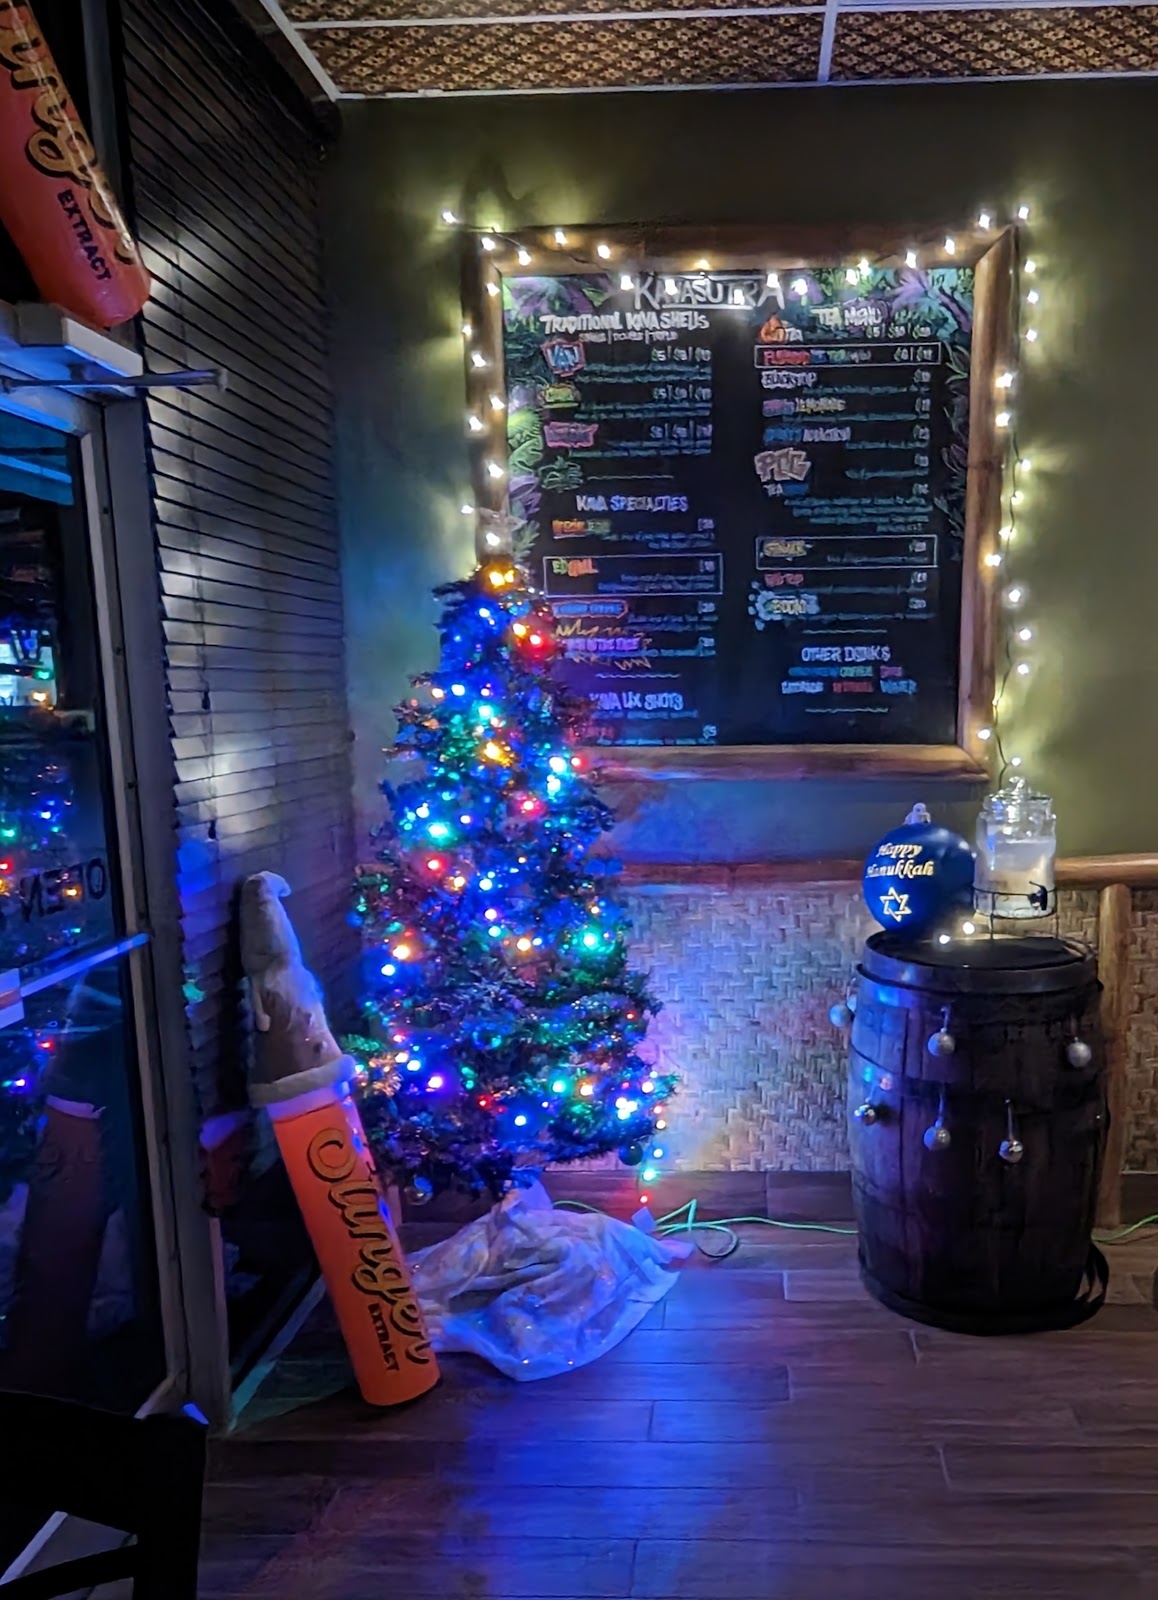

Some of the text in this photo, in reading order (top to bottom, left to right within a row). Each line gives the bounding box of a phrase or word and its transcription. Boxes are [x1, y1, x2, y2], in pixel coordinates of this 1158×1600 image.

[57, 189, 111, 281] EXTRACT
[625, 310, 660, 331] KAVA
[660, 310, 710, 330] SHELLS
[844, 306, 882, 327] MENU
[801, 646, 891, 662] OTHER DRINKS
[644, 692, 684, 711] SHOTS
[875, 842, 923, 859] Happy
[865, 859, 934, 879] Hanukkah
[367, 1302, 400, 1372] EXTRACT
